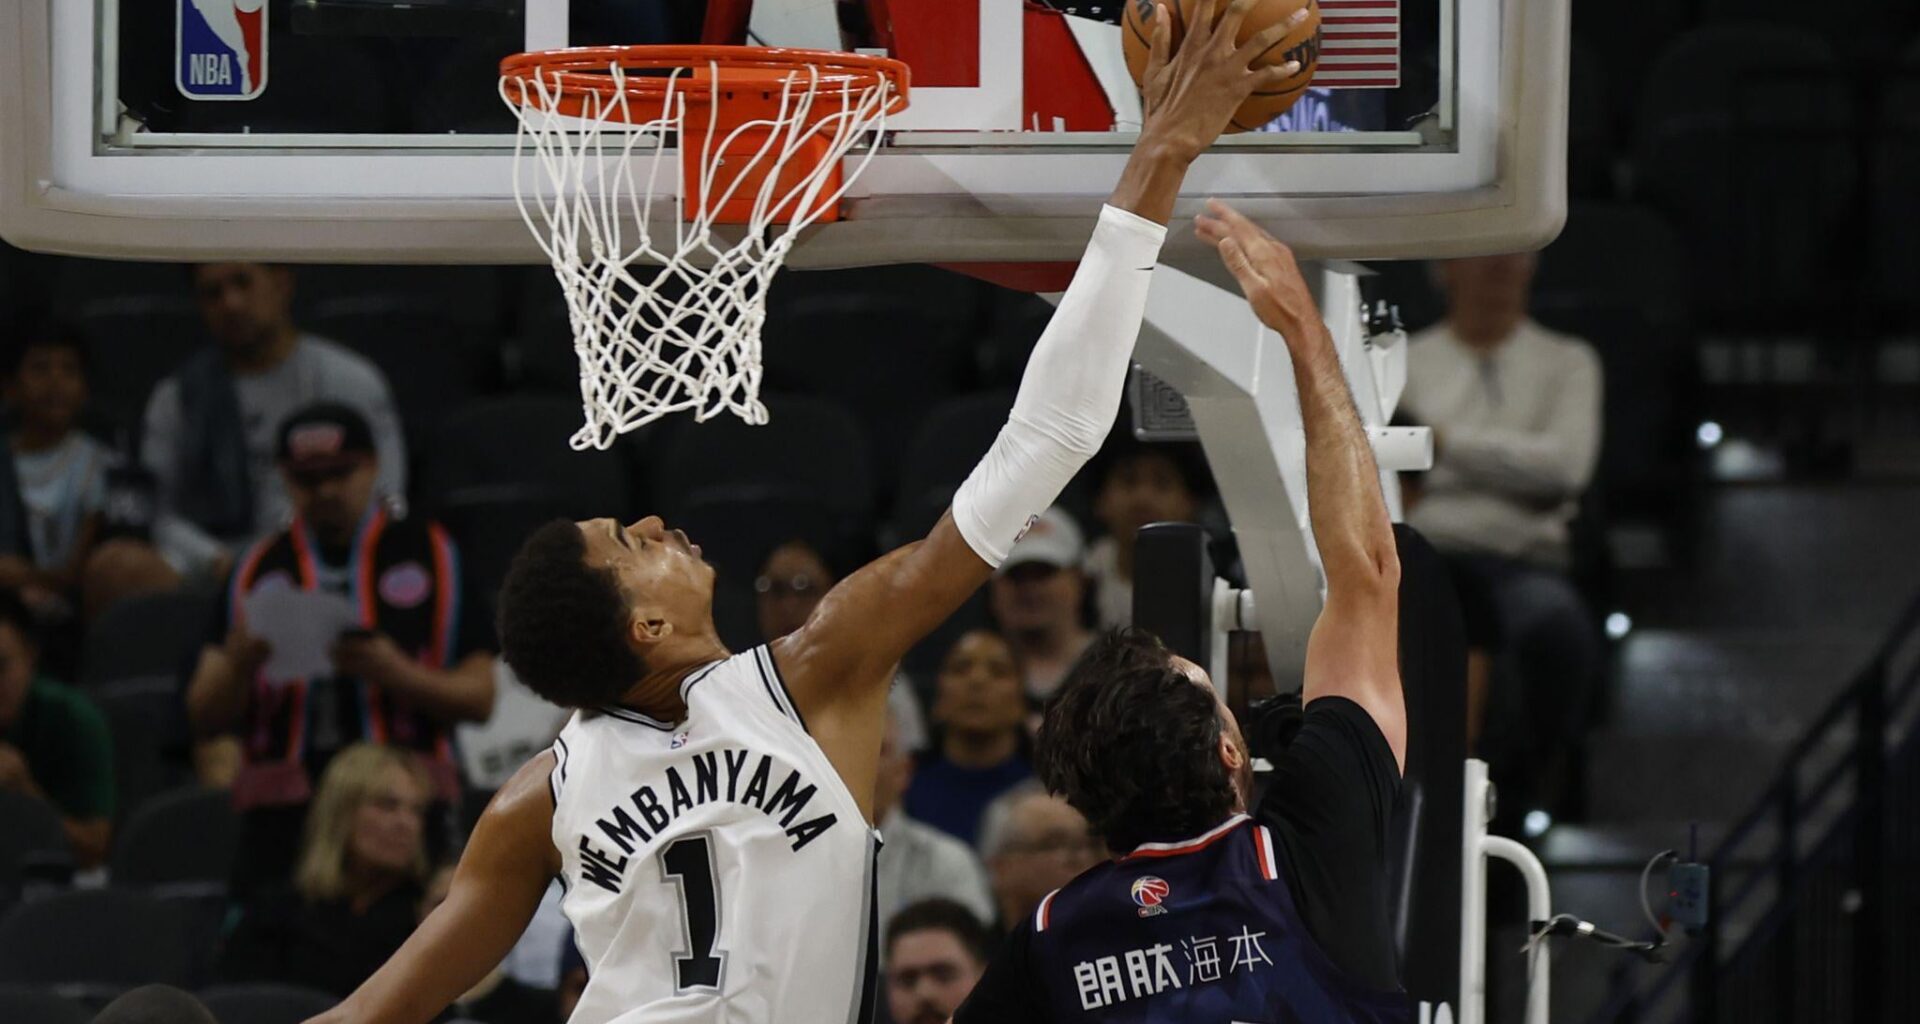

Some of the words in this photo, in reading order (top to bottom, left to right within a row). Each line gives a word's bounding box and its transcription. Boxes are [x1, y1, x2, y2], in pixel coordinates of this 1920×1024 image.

[190, 53, 232, 85] NBA
[578, 749, 838, 894] WEMBANYAMA
[656, 829, 729, 997] 1
[1073, 925, 1274, 1011] 朗肽海本
